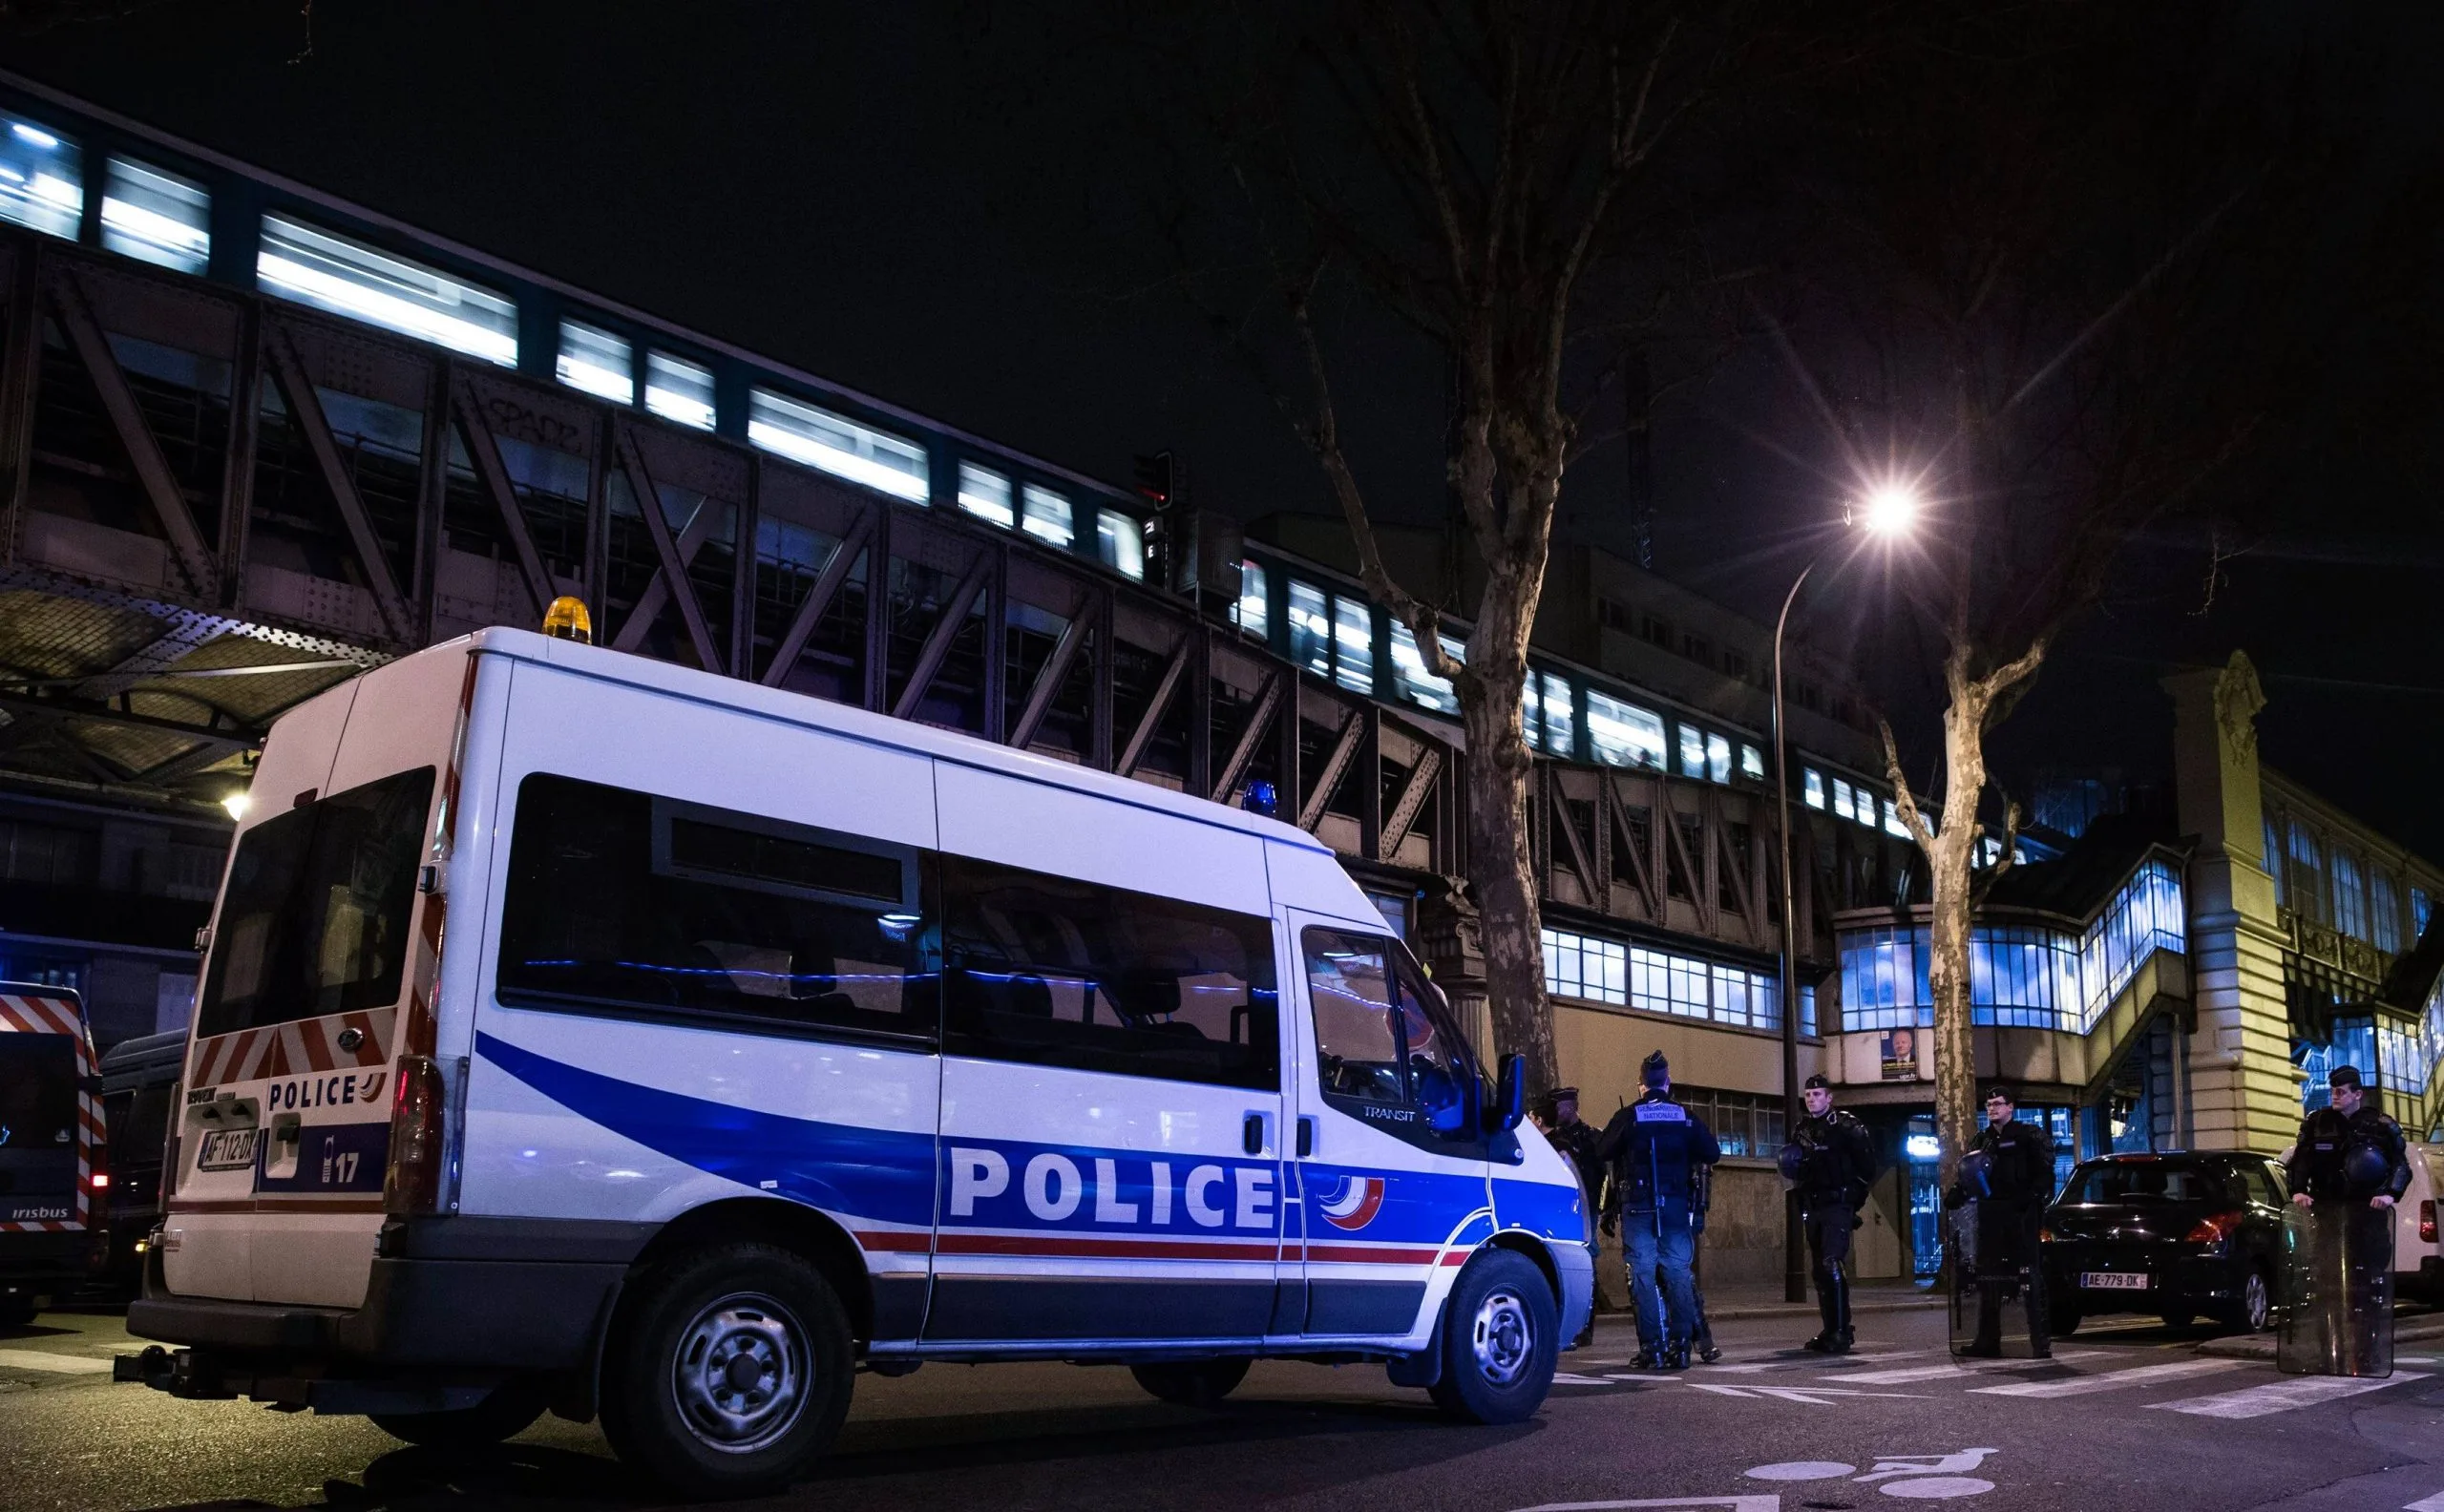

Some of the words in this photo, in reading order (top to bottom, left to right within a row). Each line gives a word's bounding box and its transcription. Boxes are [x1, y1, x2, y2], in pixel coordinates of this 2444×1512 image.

[269, 1075, 357, 1111] POLICE
[1362, 1105, 1417, 1123] TRANSIT
[335, 1152, 360, 1184] 17
[949, 1146, 1275, 1229] POLICE
[11, 1206, 69, 1220] irisbus
[2088, 1274, 2139, 1287] AE-779-DK
